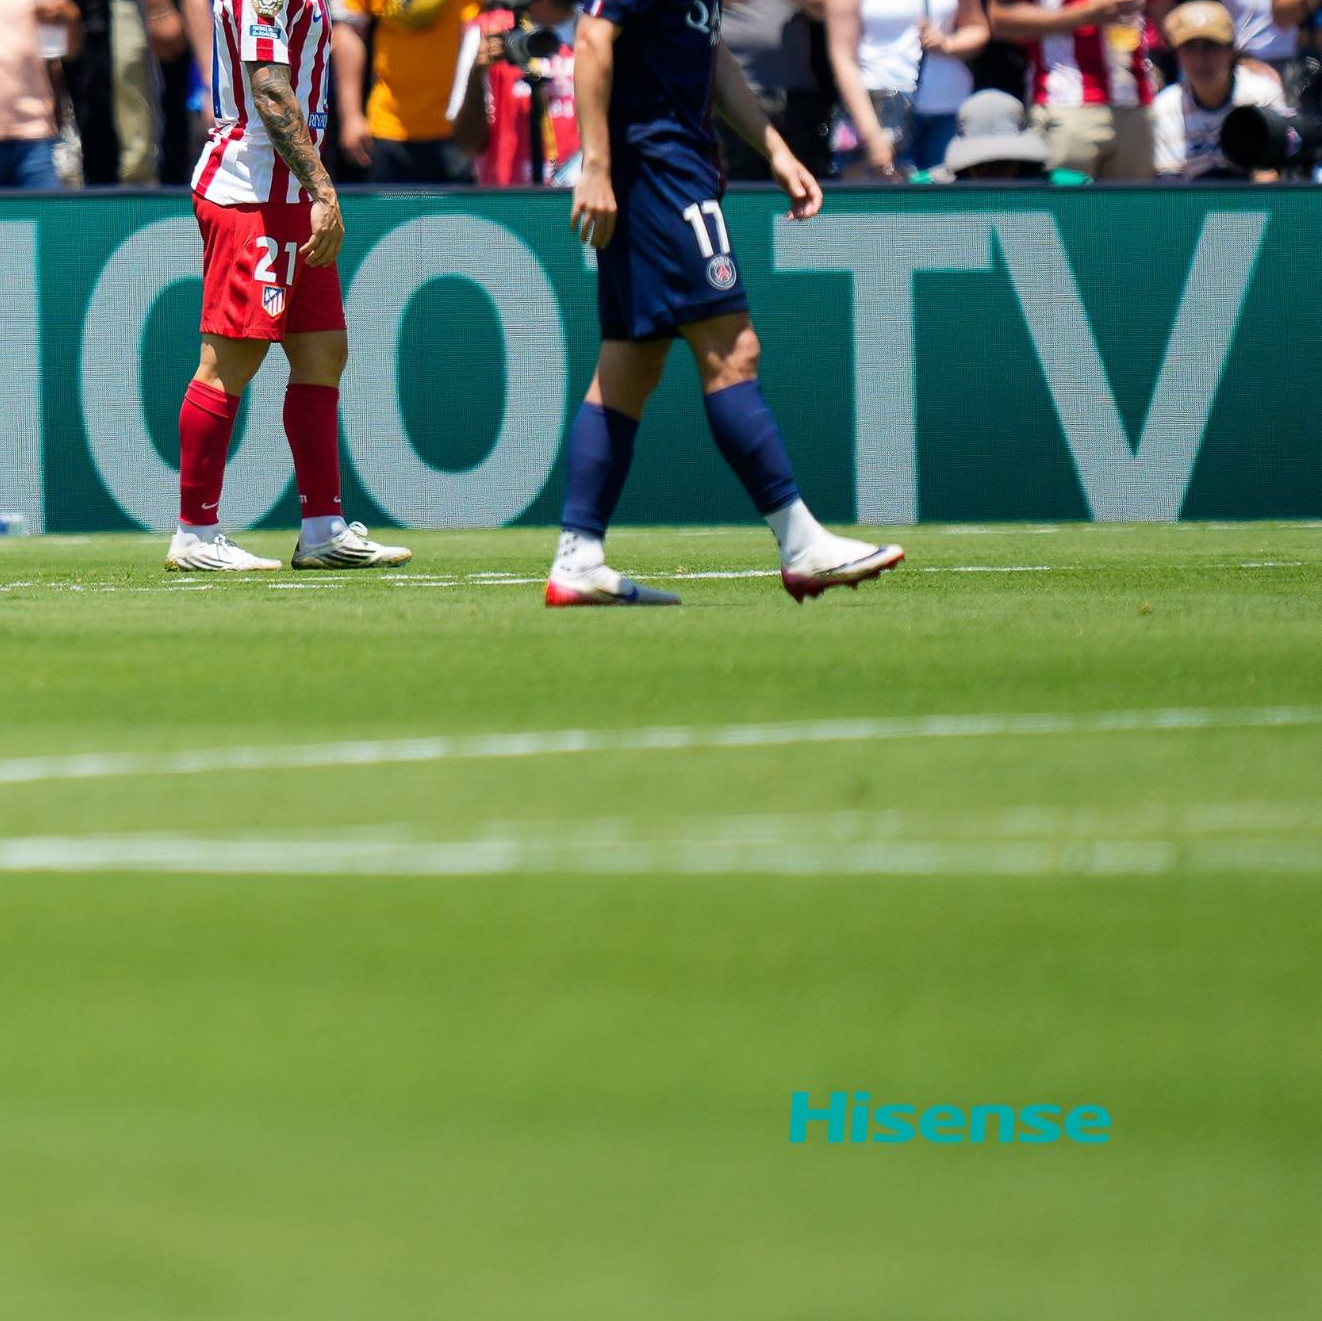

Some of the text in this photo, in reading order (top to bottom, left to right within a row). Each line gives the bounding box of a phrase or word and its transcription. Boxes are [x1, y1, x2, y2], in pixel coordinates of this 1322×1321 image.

[309, 113, 328, 128] RIYAD
[683, 200, 731, 258] 17
[254, 235, 297, 286] 21
[773, 210, 1271, 526] TV
